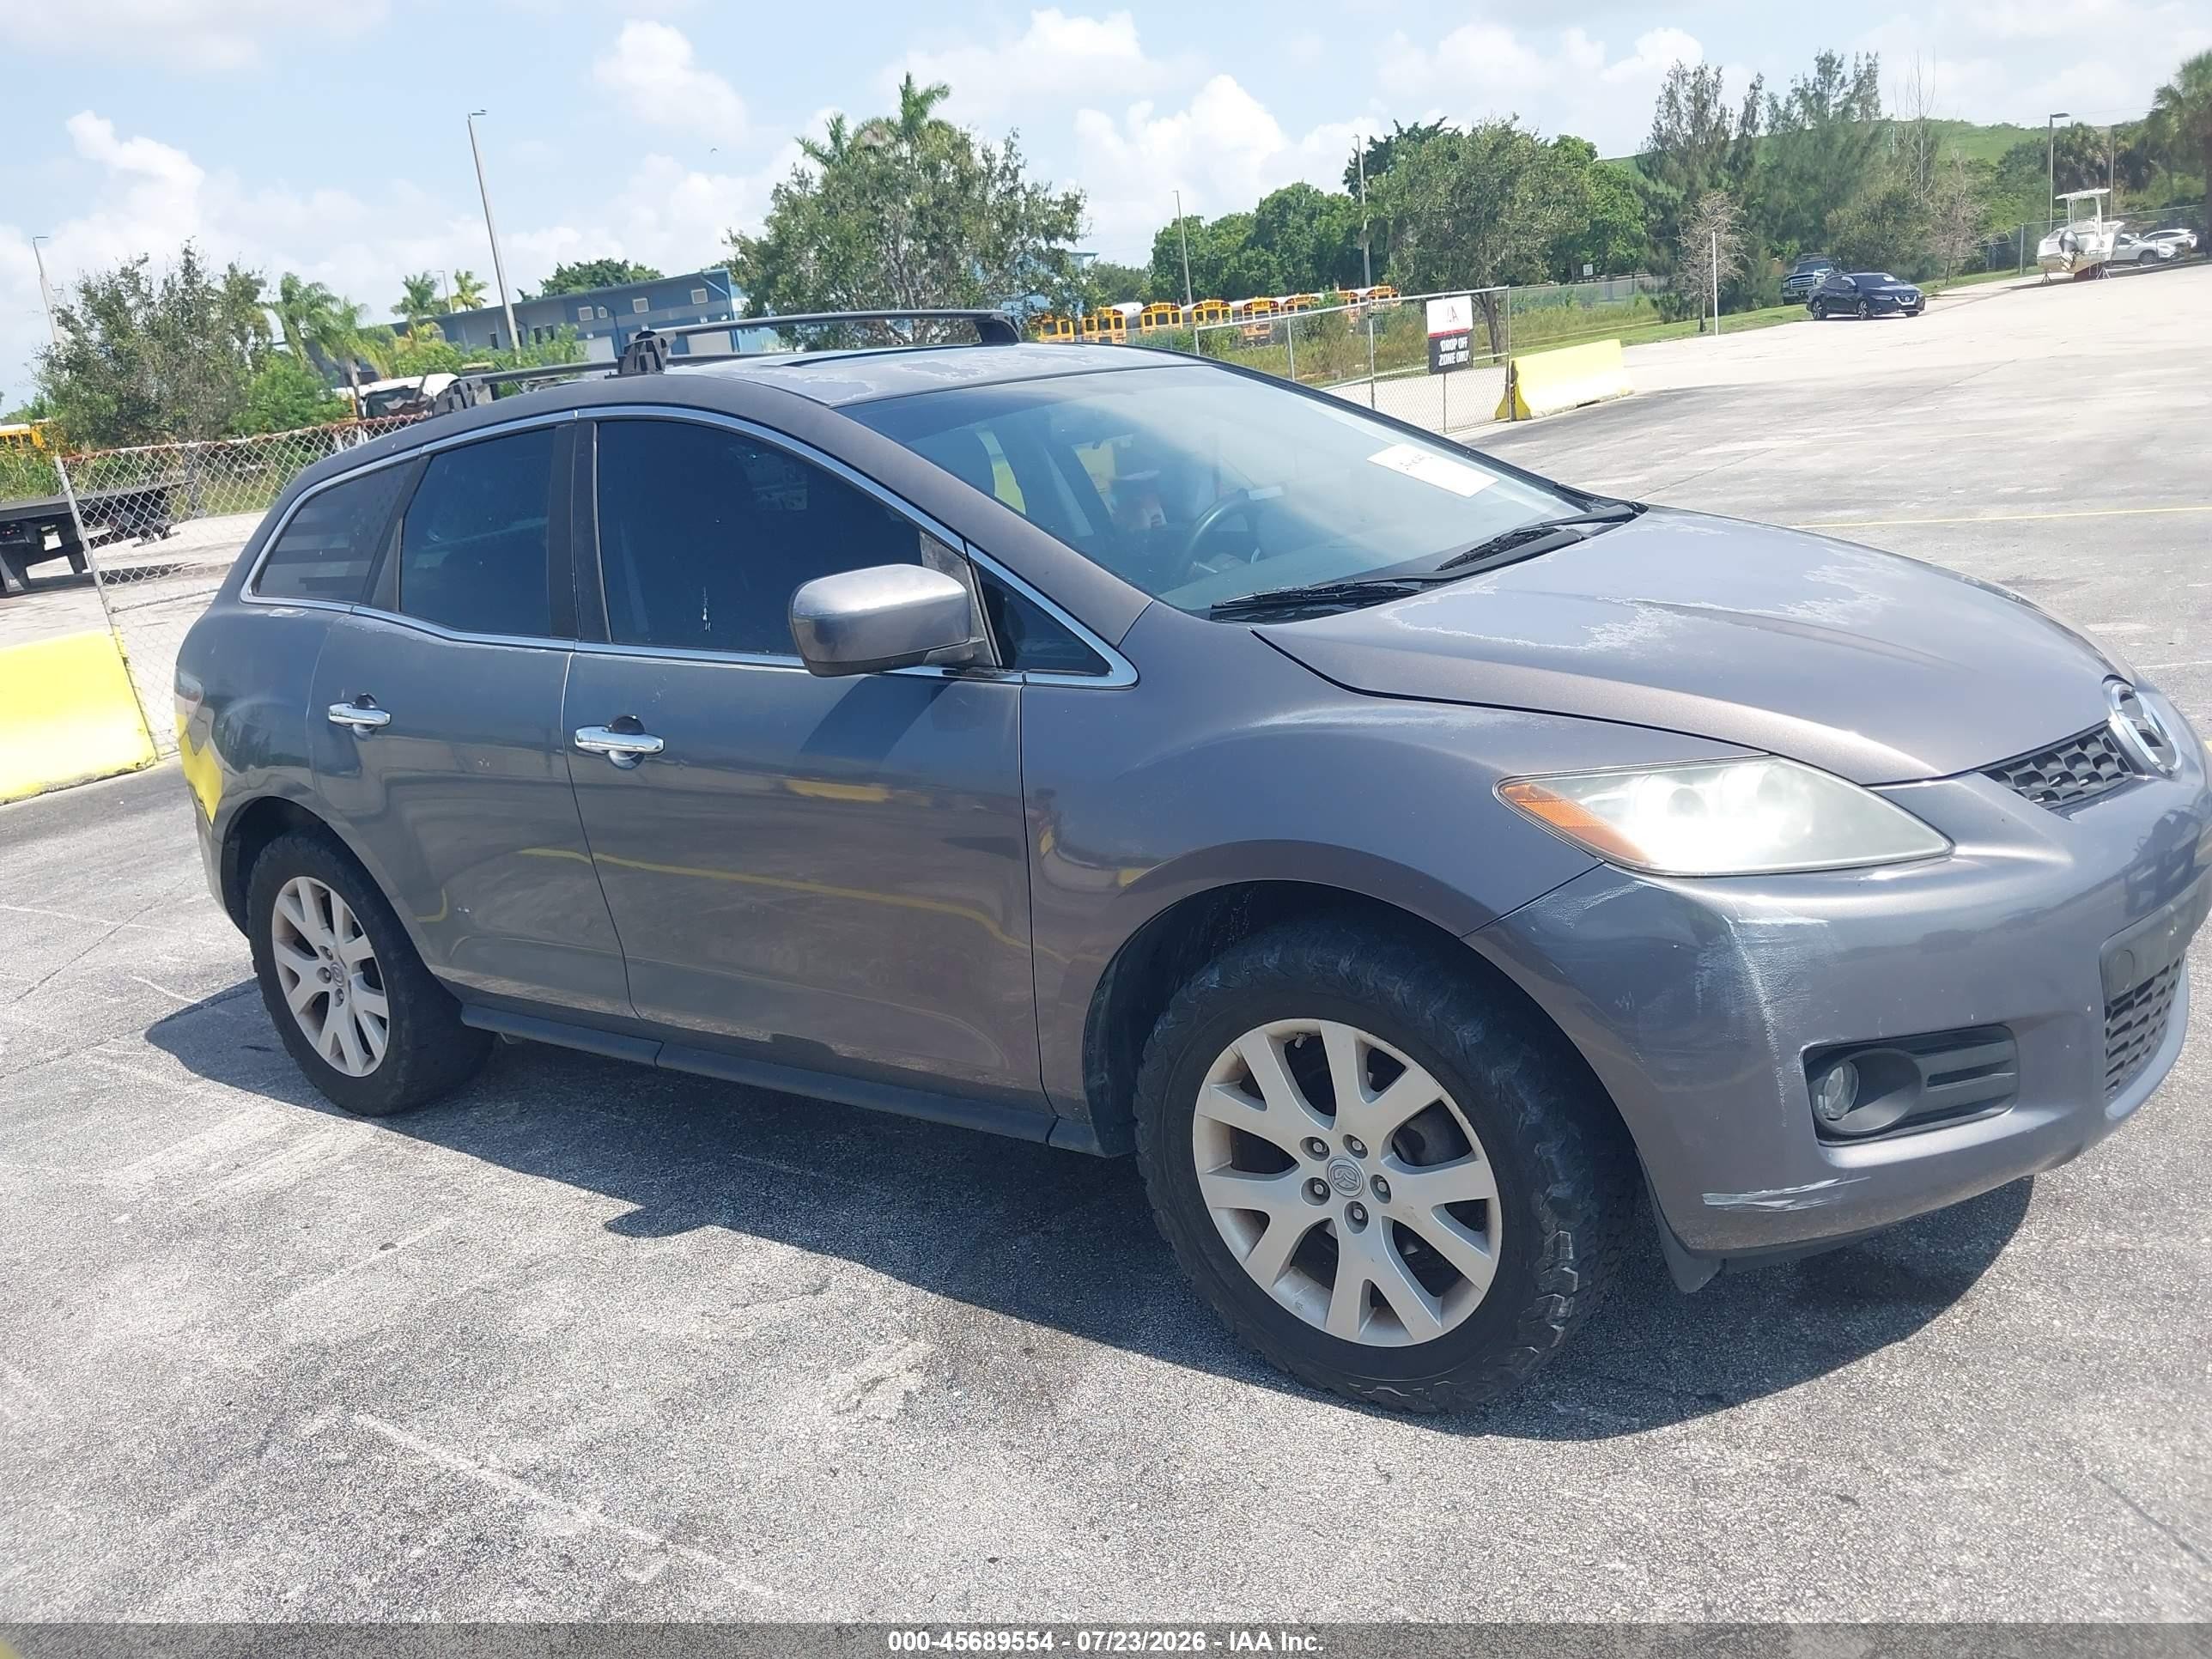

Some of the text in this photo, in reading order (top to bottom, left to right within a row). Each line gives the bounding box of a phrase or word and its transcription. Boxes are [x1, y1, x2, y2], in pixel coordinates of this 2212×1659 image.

[1440, 337, 1468, 352] DROP OFF
[1438, 350, 1469, 367] ZONE ONLY
